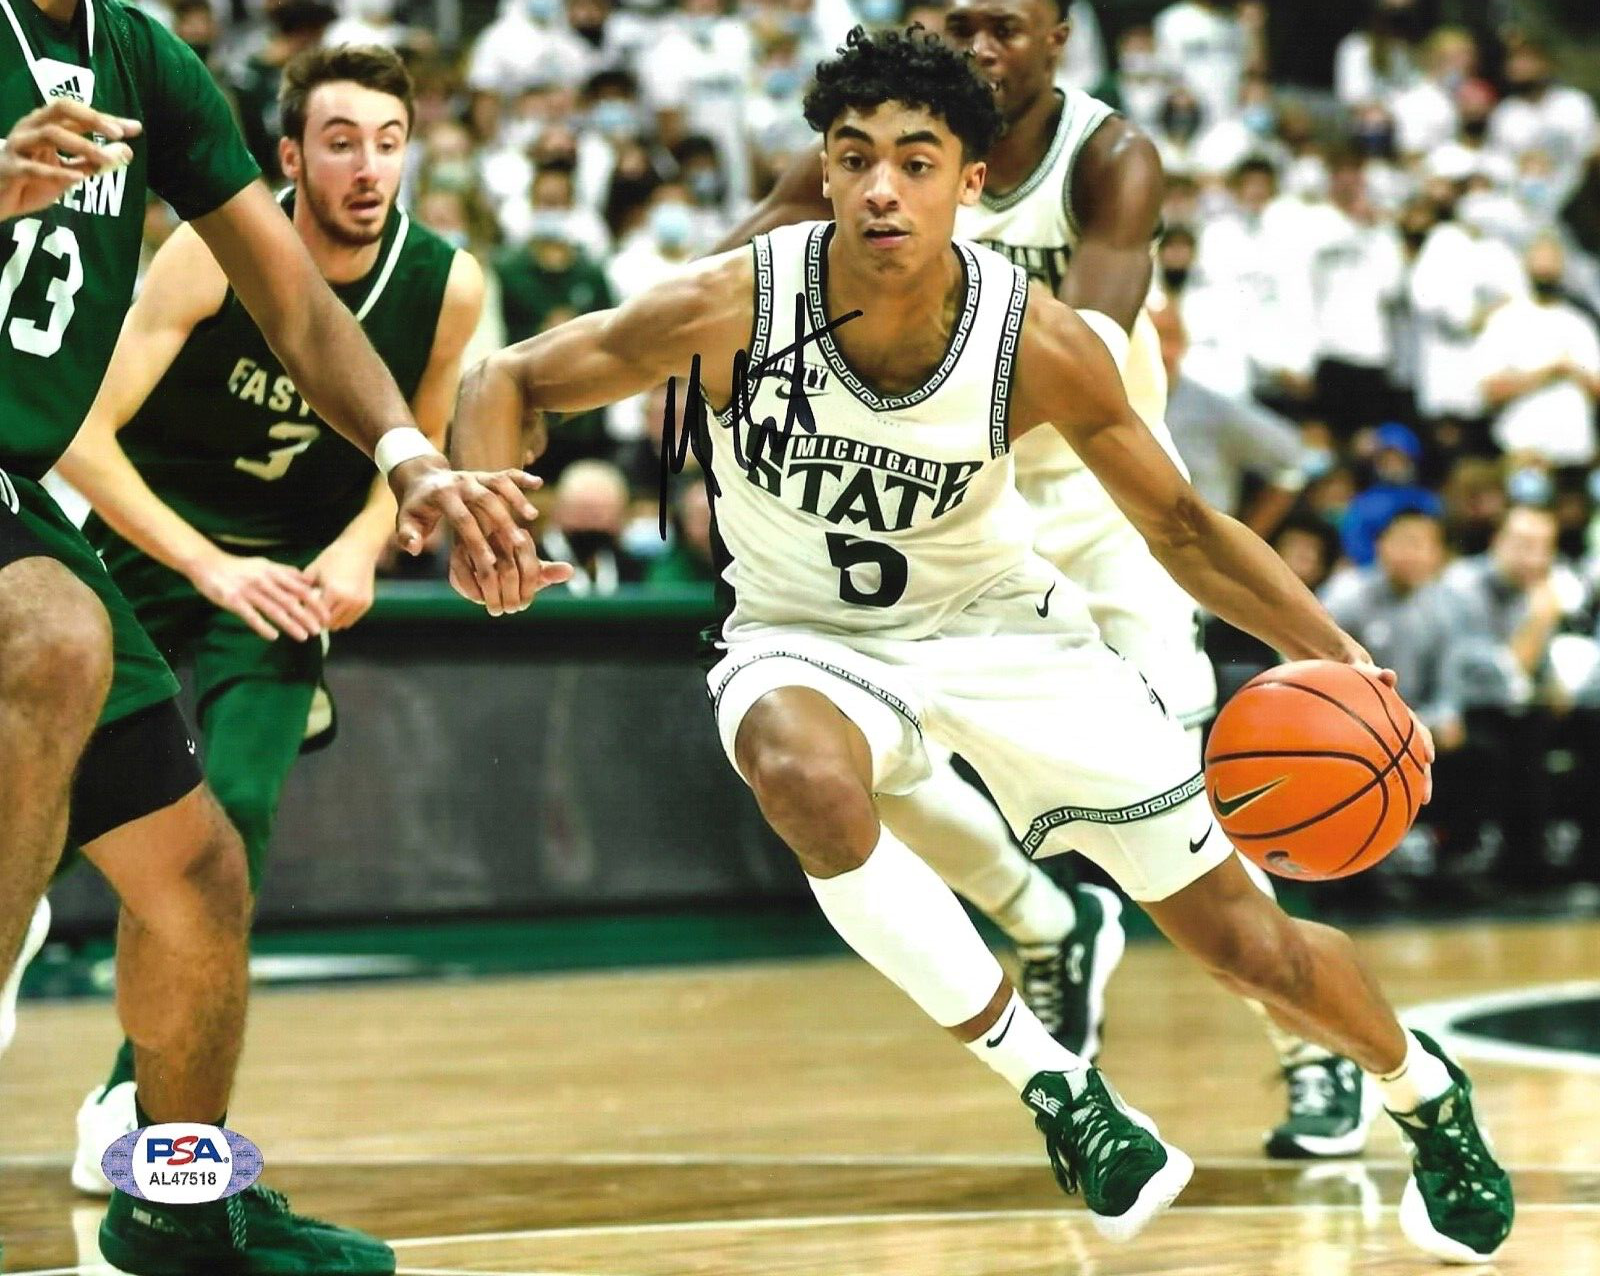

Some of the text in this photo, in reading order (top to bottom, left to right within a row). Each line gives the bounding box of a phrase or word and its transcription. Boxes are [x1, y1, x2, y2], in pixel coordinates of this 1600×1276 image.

[0, 217, 84, 358] 13
[234, 421, 320, 481] 3
[746, 423, 984, 532] STATE
[795, 436, 939, 482] MICHIGAN
[825, 532, 908, 608] 5
